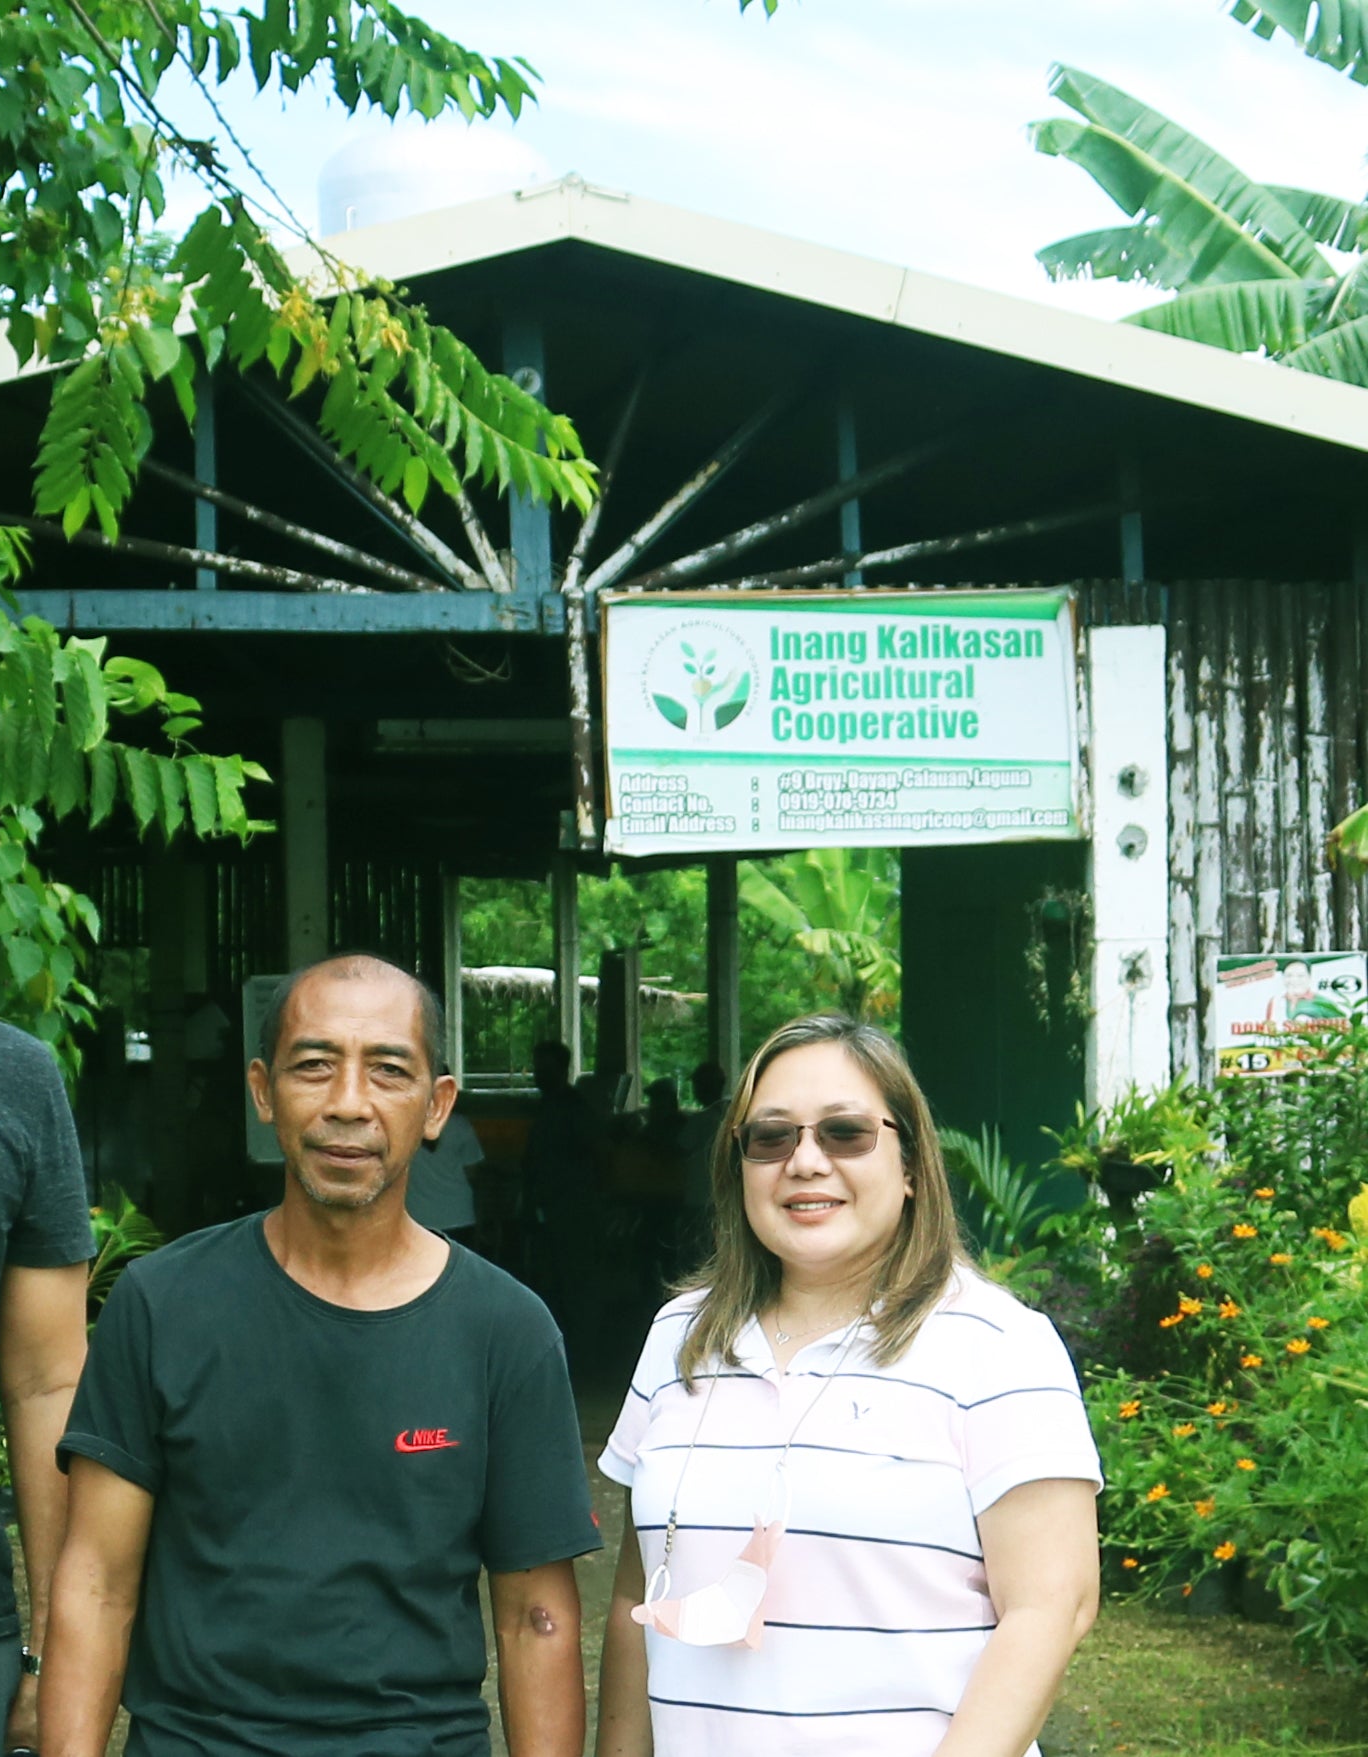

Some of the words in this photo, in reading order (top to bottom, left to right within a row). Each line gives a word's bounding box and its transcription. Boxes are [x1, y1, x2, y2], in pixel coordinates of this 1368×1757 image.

[770, 625, 868, 665] Inang
[877, 624, 1044, 660] Kalikasan
[770, 664, 975, 705] Agricultural
[771, 704, 980, 744] Cooperative
[619, 773, 688, 793] Address
[778, 770, 803, 791] #9
[973, 767, 1031, 789] Laguna
[620, 793, 685, 813] Contact
[686, 793, 713, 813] No.
[779, 790, 898, 811] 0919-078-9734
[620, 814, 667, 835] Email
[668, 814, 736, 834] Address
[412, 1429, 448, 1445] NIKE
